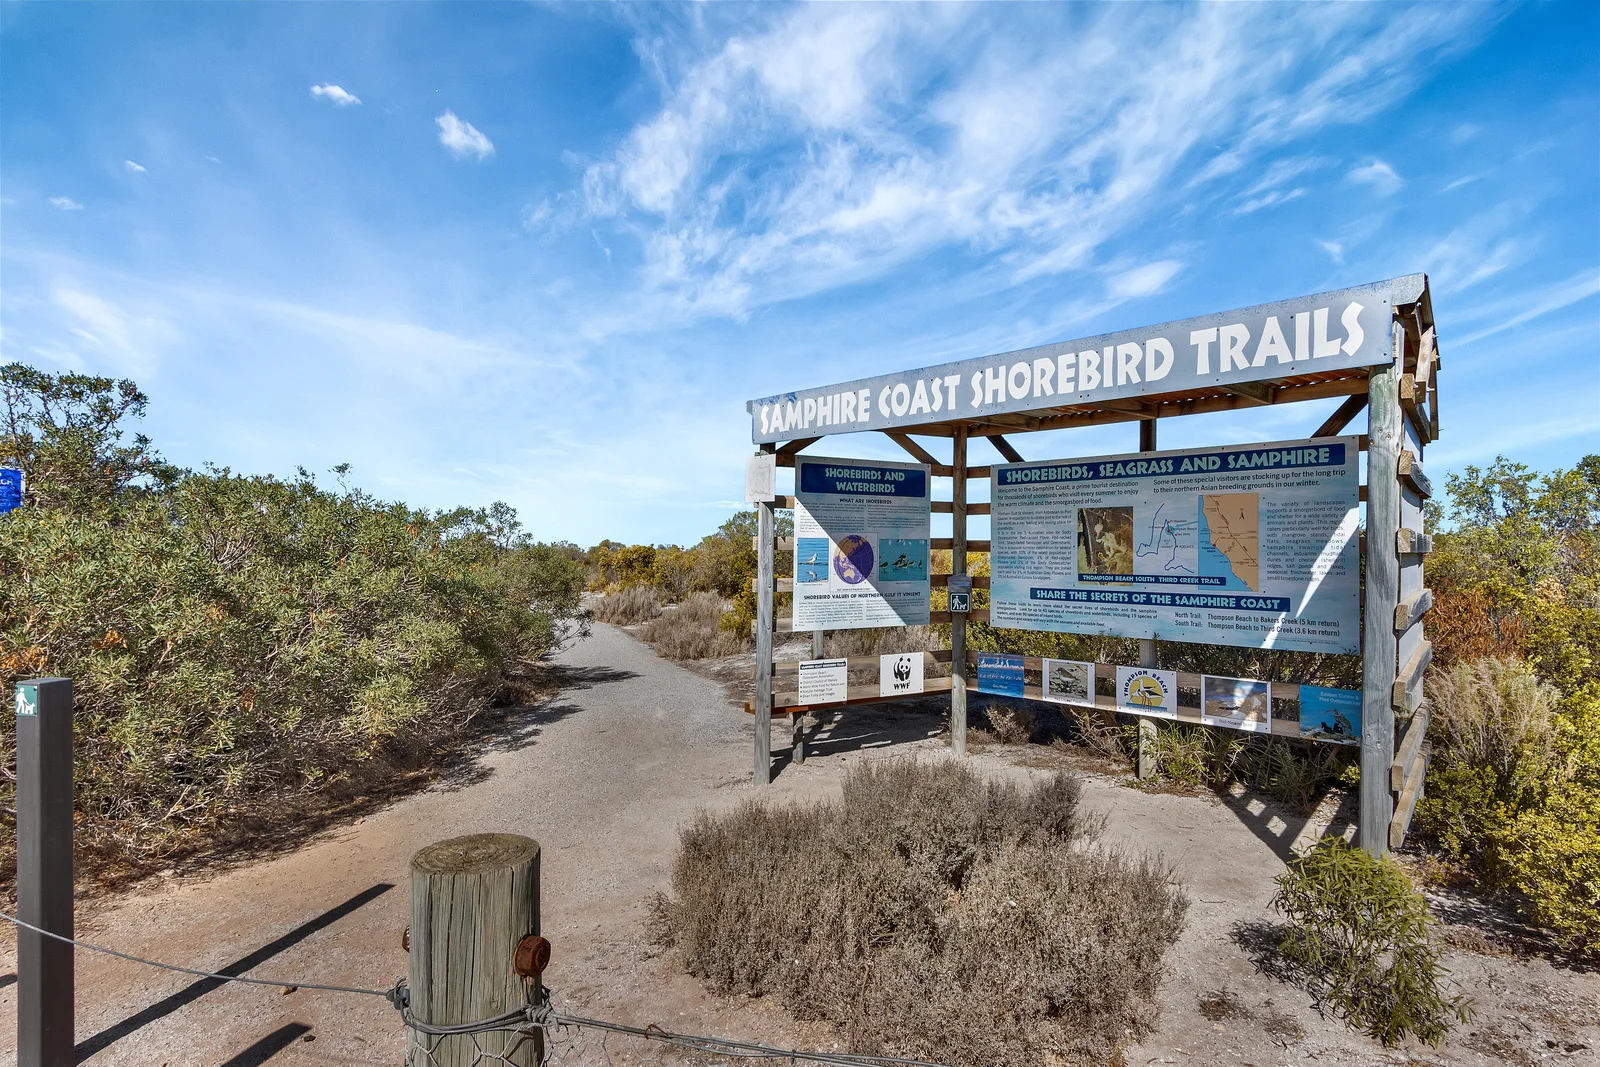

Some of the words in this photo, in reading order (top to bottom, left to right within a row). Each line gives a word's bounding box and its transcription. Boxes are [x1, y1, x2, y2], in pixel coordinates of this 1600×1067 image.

[760, 388, 870, 436] SAMPHIRE
[879, 374, 960, 418] COAST
[970, 338, 1174, 408] SHOREBIRD
[1190, 302, 1366, 375] TRAILS
[1006, 465, 1094, 483] SHOREBIRDS,
[1099, 460, 1174, 477] SEAGRASS
[1180, 456, 1221, 472] AND
[1228, 448, 1330, 469] SAMPHIRE
[825, 468, 882, 480] SHOREBIRDS
[884, 472, 906, 482] AND
[1194, 476, 1216, 485] special
[1252, 473, 1280, 482] stocking
[1315, 470, 1332, 479] long
[1332, 469, 1346, 478] trip
[836, 482, 896, 494] WATERBIRDS
[1032, 485, 1055, 493] Samphire
[1218, 483, 1247, 492] breeding
[1247, 482, 1274, 491] grounds
[1052, 498, 1084, 507] smorgasbord
[1036, 590, 1066, 600] SHARE
[1069, 591, 1087, 601] THE
[1090, 592, 1129, 602] SECRETS
[1132, 594, 1146, 603] OF
[1150, 595, 1171, 604] THE
[1175, 596, 1236, 607] SAMPHIRE
[1240, 598, 1280, 610] COAST
[1207, 614, 1235, 623] Thompson
[1299, 618, 1306, 626] (5
[1317, 619, 1340, 628] return)
[1207, 622, 1235, 631] Thompson
[1294, 626, 1306, 635] (3.6
[1318, 628, 1340, 637] return)
[1123, 670, 1148, 697] THOMPSON
[1152, 673, 1169, 694] BEACH
